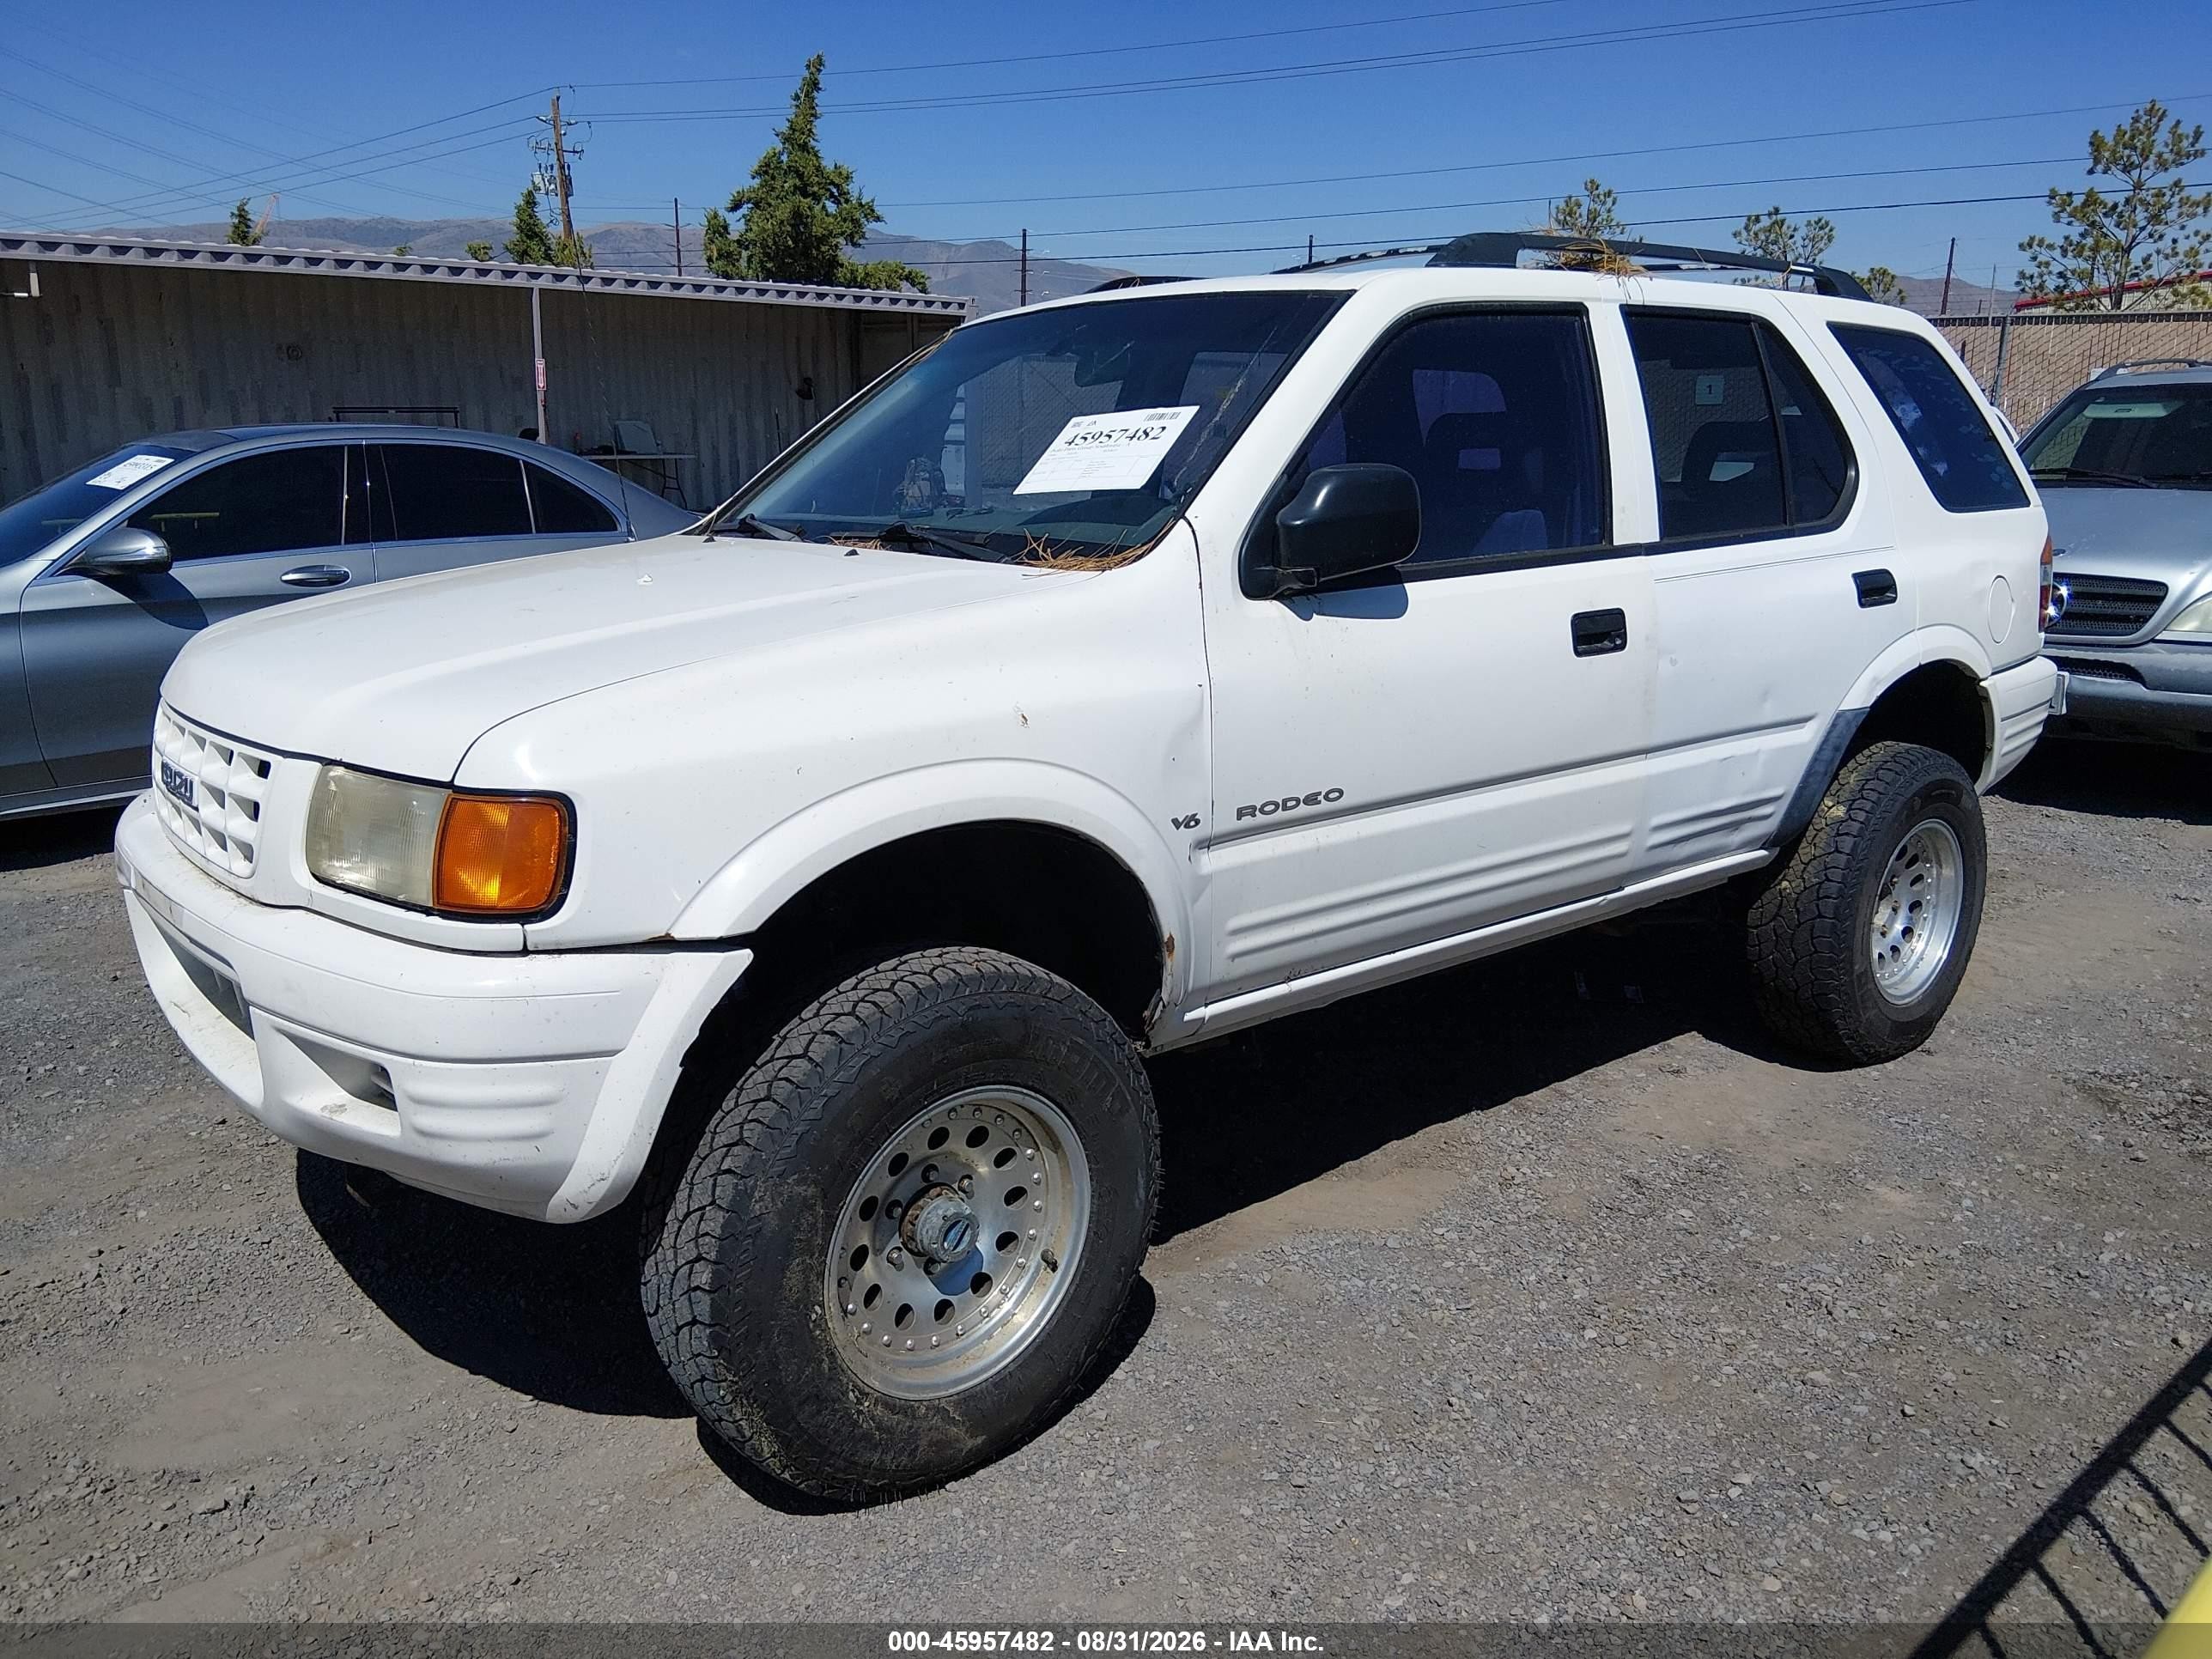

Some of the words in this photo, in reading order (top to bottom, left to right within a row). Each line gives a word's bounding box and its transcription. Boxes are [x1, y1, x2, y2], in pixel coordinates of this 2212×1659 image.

[1064, 426, 1167, 447] 45957482
[1236, 787, 1345, 821] RODEO
[1170, 812, 1201, 831] V6
